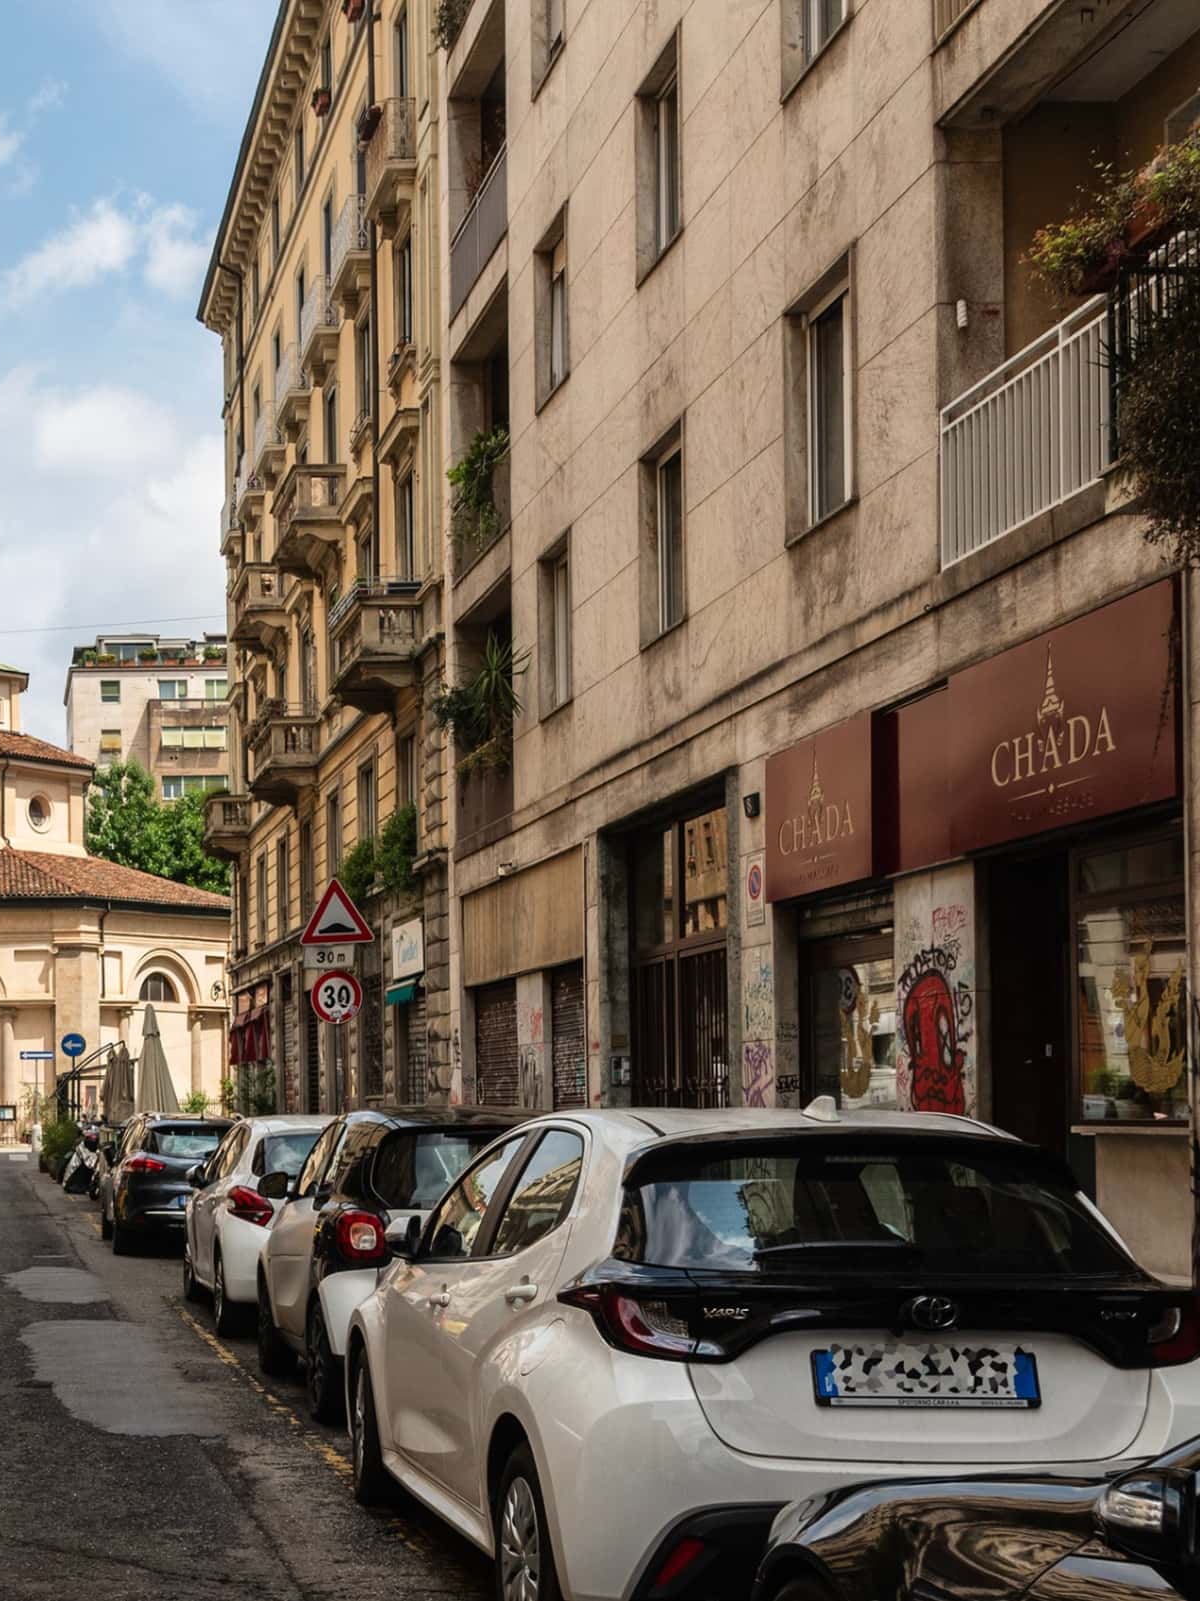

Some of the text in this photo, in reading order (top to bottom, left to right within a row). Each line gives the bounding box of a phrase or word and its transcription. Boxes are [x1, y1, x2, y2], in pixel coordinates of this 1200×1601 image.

[990, 707, 1117, 788] CHADA
[778, 802, 855, 856] CHADA
[316, 951, 346, 963] 30 m
[323, 985, 351, 1009] 30
[703, 1307, 750, 1320] YARIS
